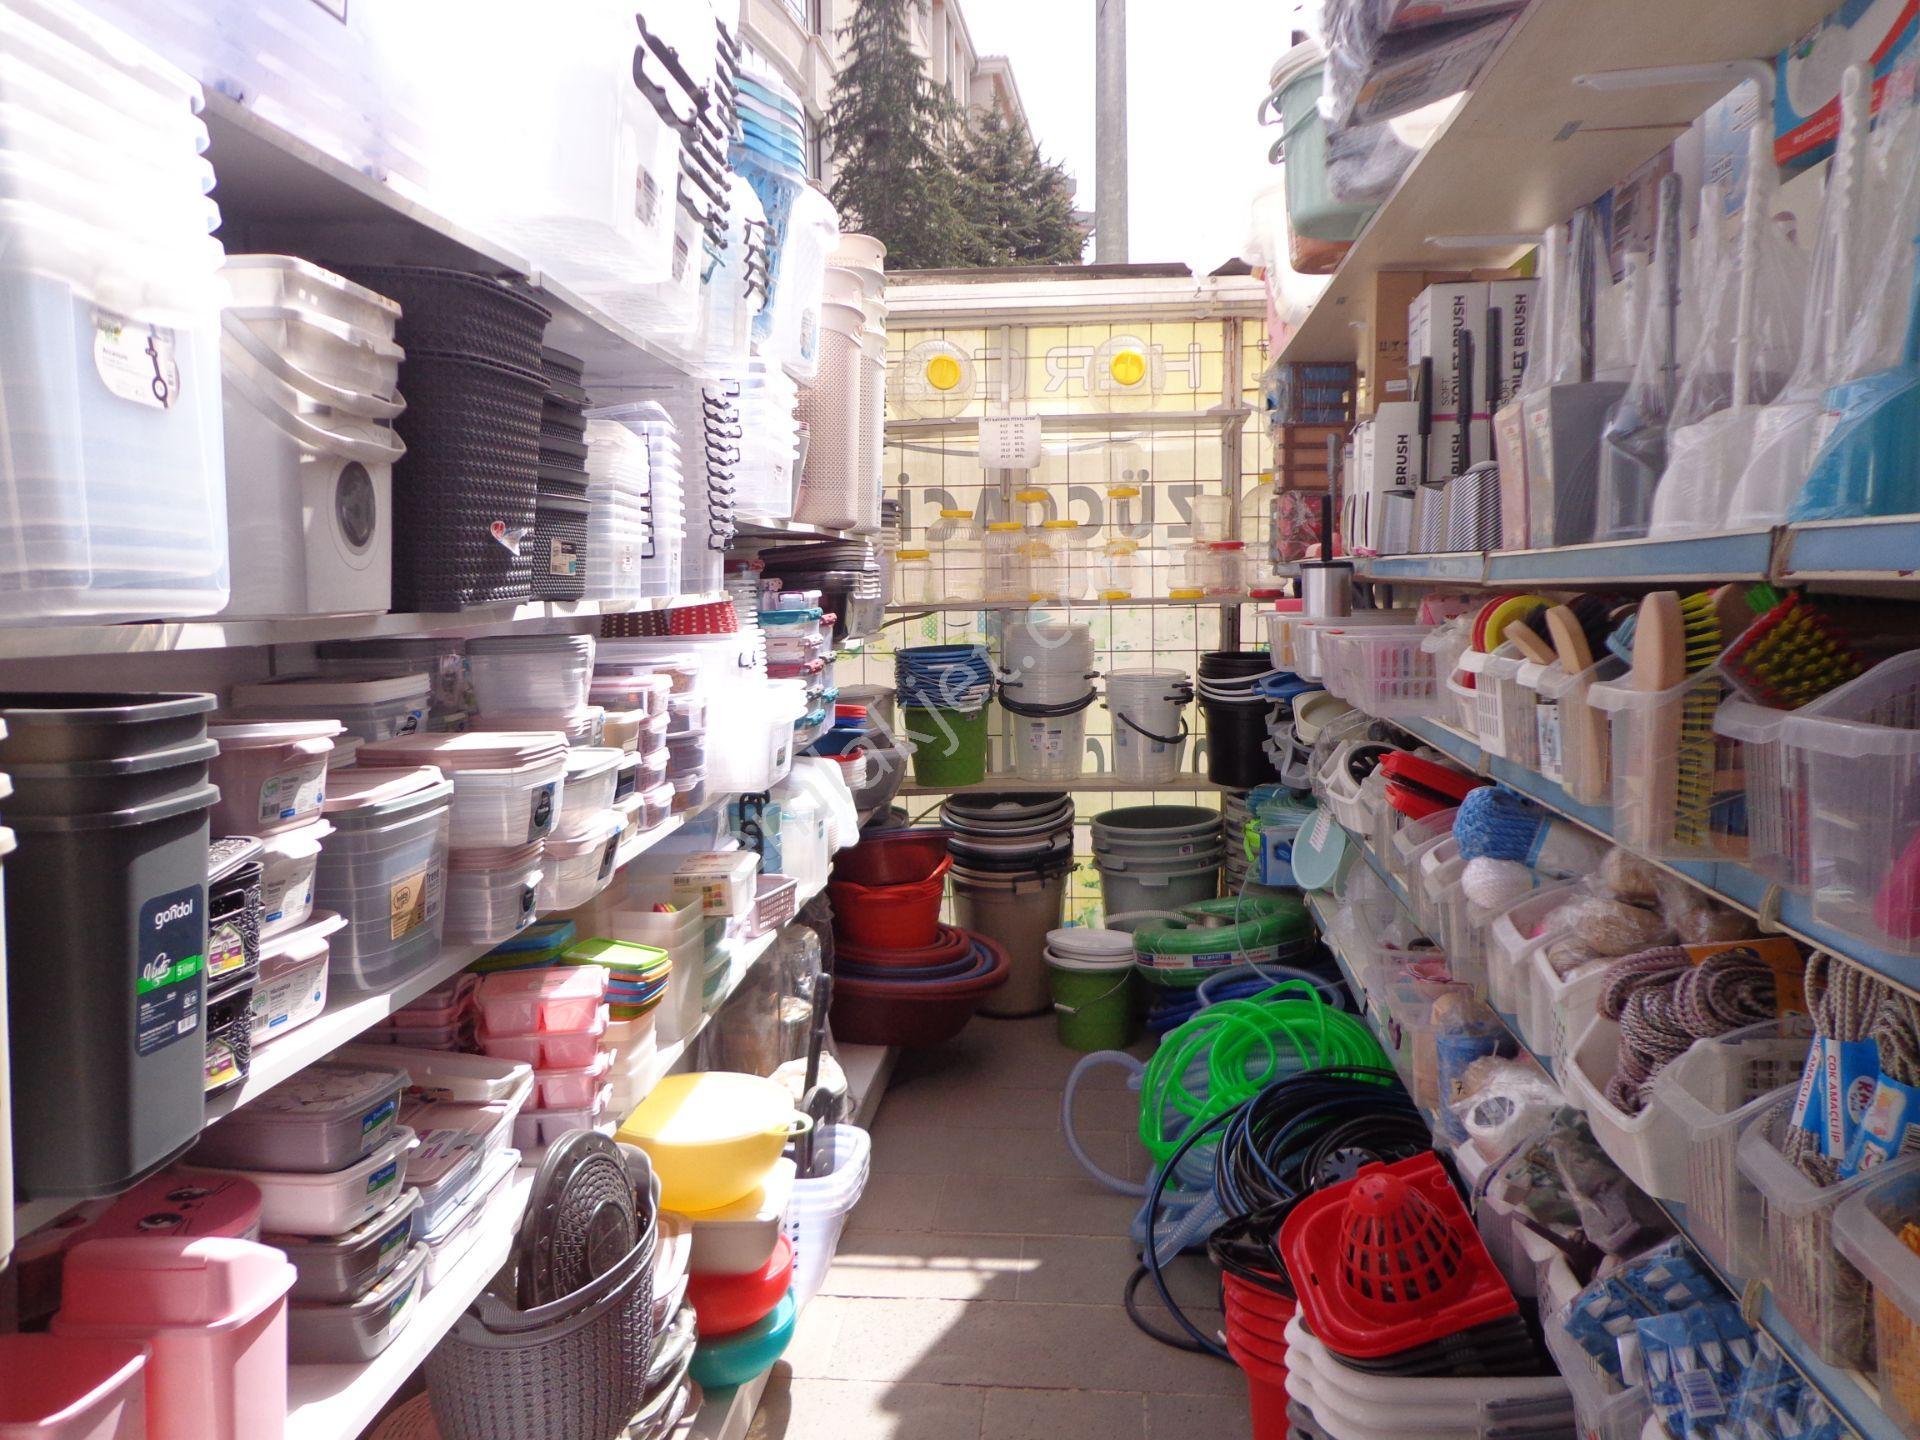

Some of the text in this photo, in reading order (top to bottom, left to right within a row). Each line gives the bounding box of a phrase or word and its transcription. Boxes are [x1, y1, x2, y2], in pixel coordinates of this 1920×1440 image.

[1511, 294, 1527, 400] OILET BRUSH
[1440, 377, 1450, 406] SOFT
[1396, 434, 1408, 486] BRUSH
[155, 899, 193, 930] gondol
